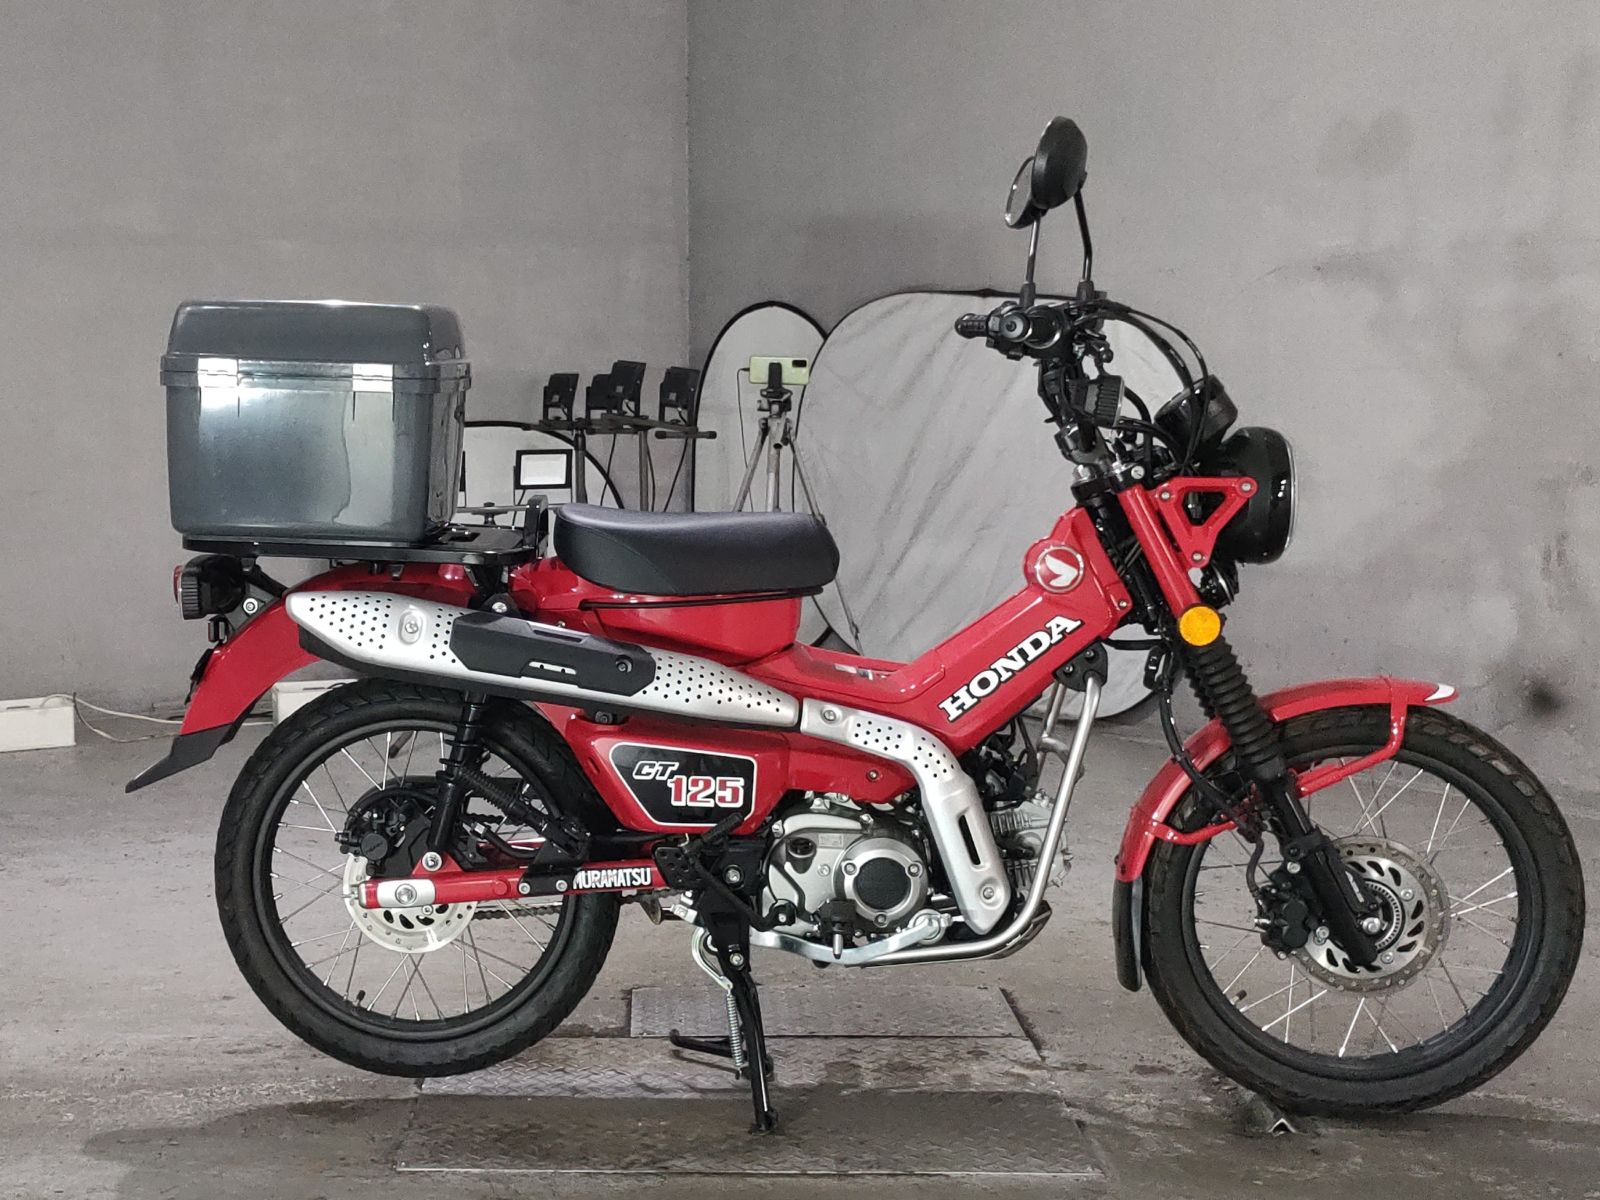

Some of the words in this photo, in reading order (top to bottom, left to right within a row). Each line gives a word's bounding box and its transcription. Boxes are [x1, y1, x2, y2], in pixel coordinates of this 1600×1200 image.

[938, 615, 1083, 722] HONDA
[632, 760, 679, 781] CT
[667, 775, 745, 808] 125
[572, 867, 652, 890] MURAMATSU
